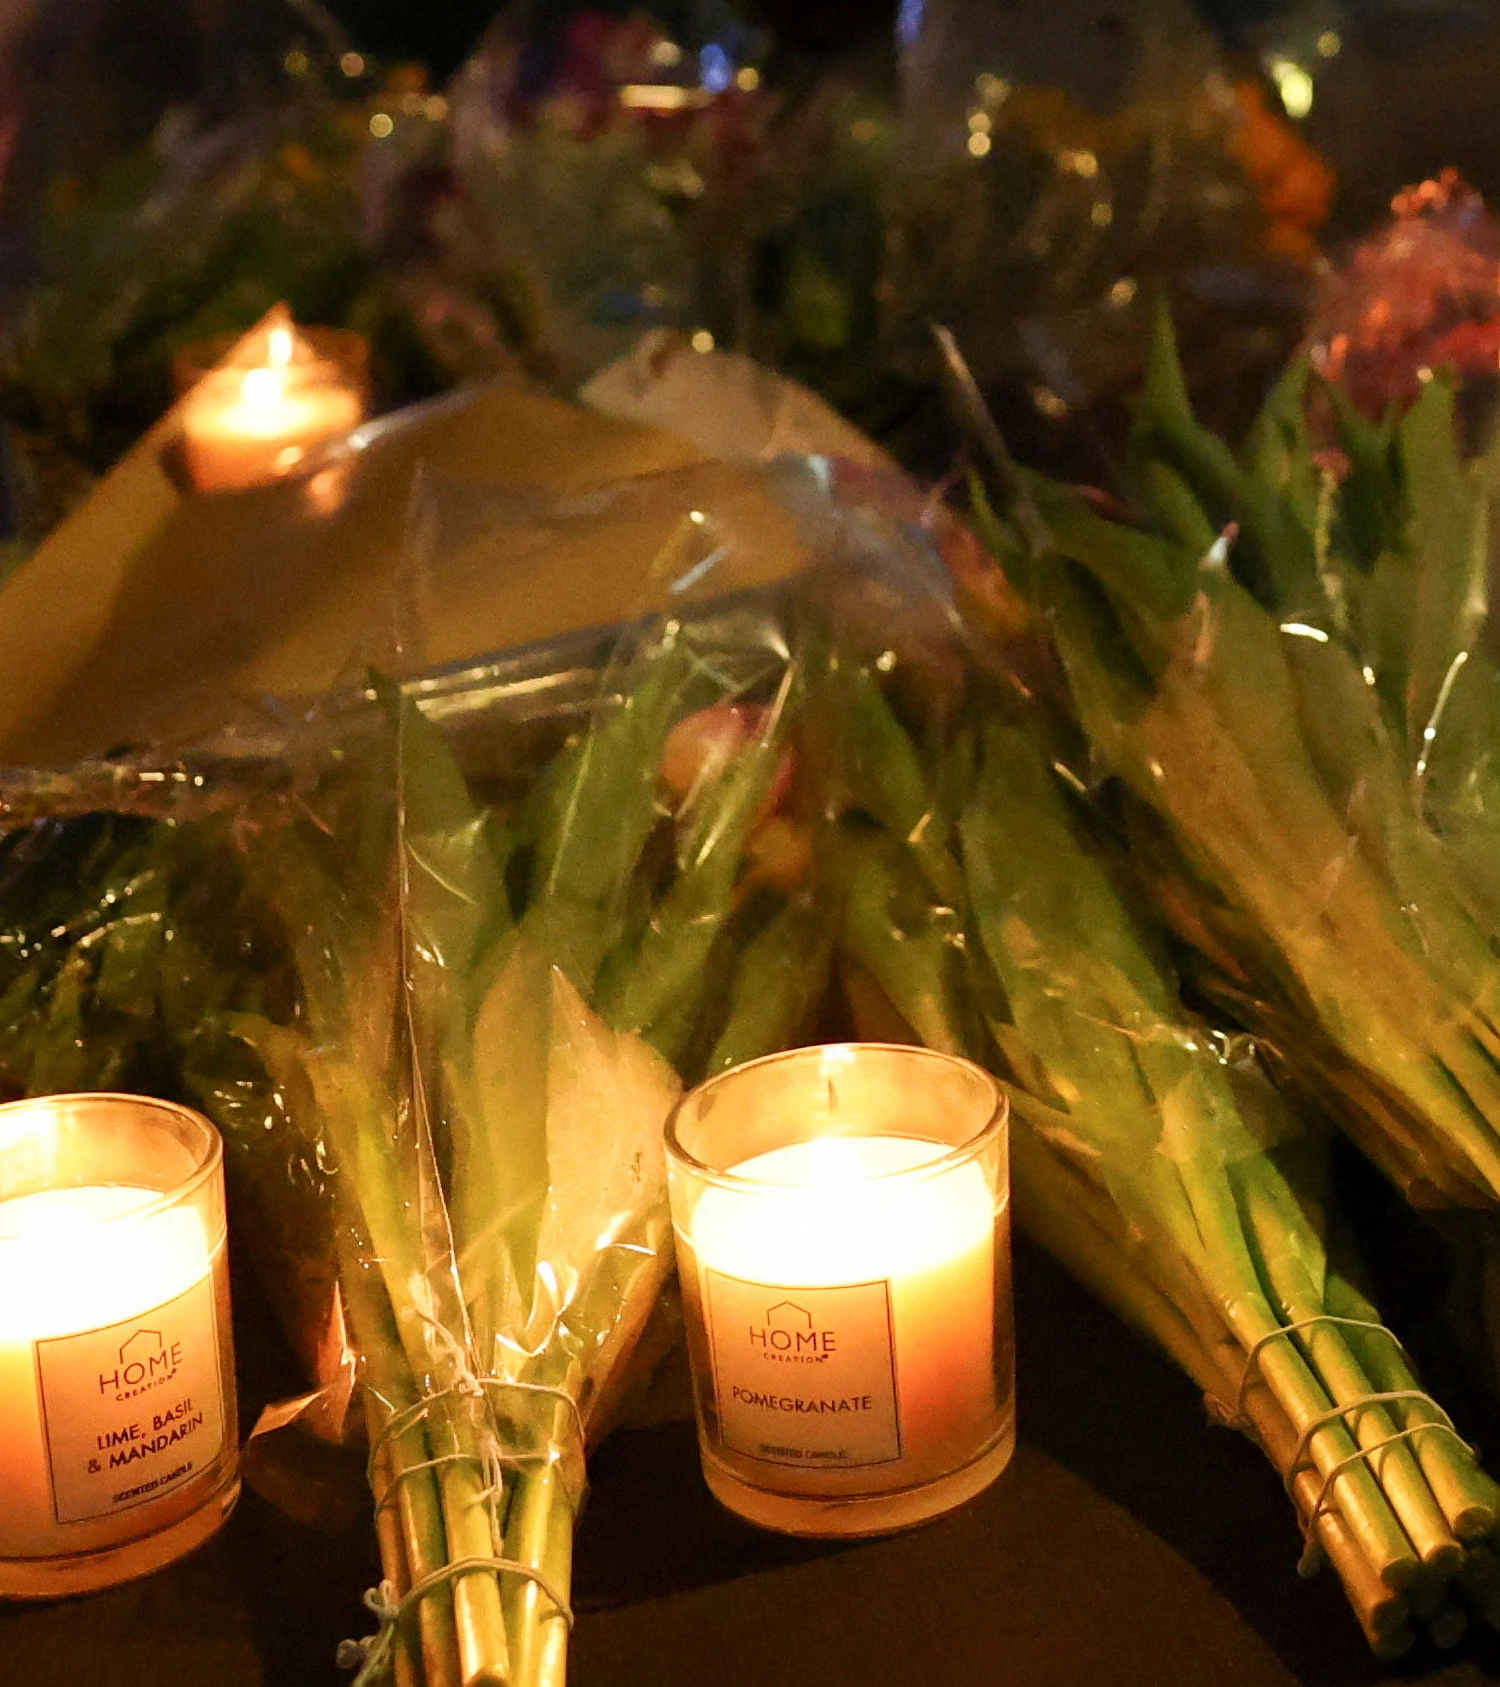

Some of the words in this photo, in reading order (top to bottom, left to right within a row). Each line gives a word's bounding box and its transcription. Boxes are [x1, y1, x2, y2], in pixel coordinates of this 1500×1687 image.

[749, 1325, 836, 1352] HOME
[99, 1341, 183, 1394] HOME
[97, 1423, 146, 1451] LIME,
[152, 1398, 193, 1431] BASIL
[732, 1385, 873, 1413] POMEGRANATE
[87, 1458, 102, 1474] &
[109, 1412, 203, 1470] MANDARIN
